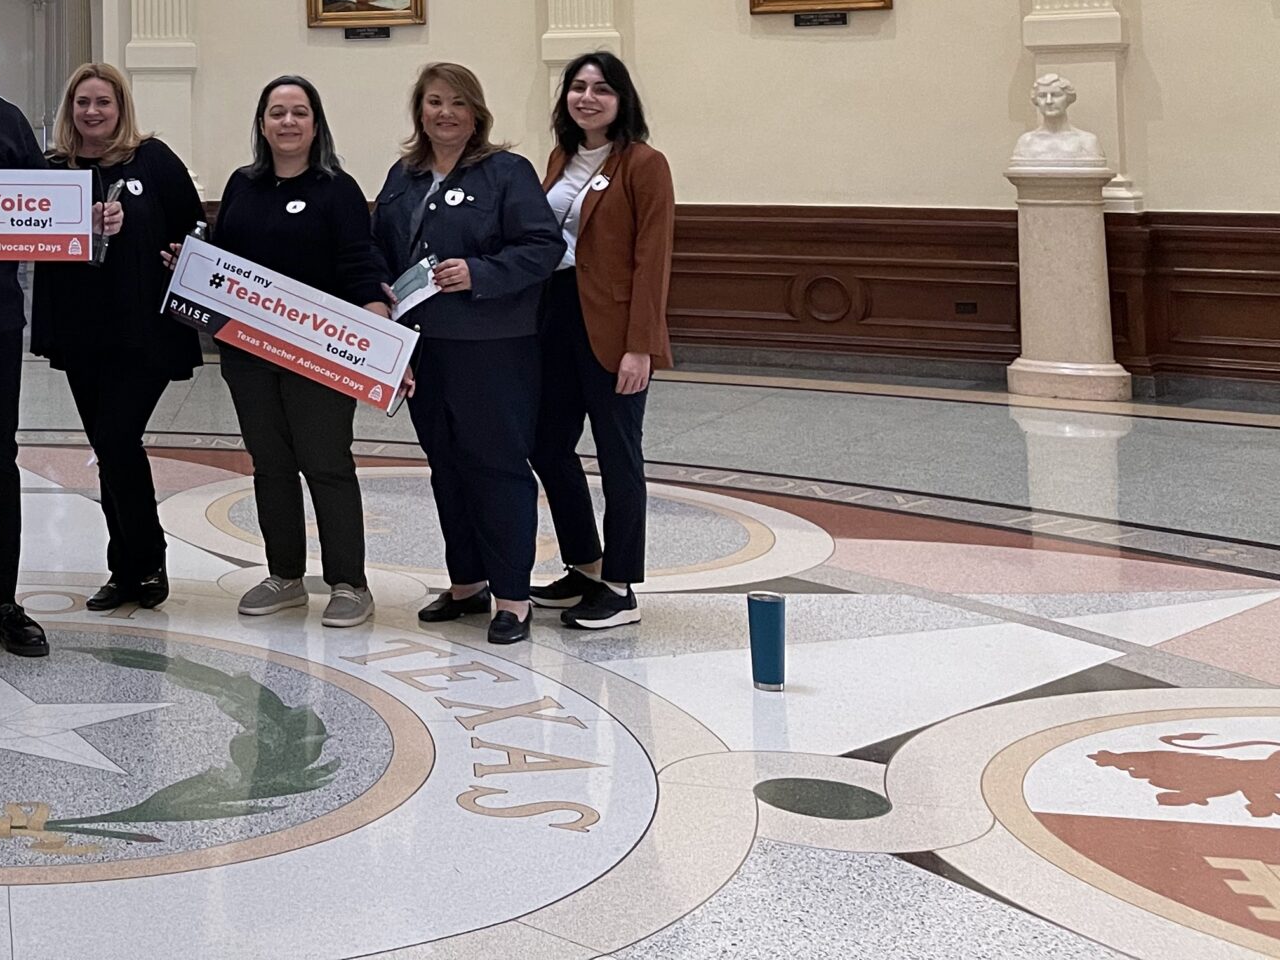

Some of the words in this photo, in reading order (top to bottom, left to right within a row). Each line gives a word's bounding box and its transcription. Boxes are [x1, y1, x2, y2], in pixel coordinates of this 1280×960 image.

[10, 217, 52, 228] today!
[38, 243, 62, 254] Days
[216, 257, 221, 266] I
[223, 263, 252, 279] used
[253, 274, 272, 289] my
[170, 299, 210, 324] RAISE
[209, 272, 371, 352] #TeacherVoice
[236, 330, 261, 348] Texas
[262, 341, 296, 362] Teacher
[296, 356, 341, 382] Advocacy
[342, 375, 365, 392] Days
[326, 343, 366, 367] today!
[338, 638, 609, 833] TEXAS
